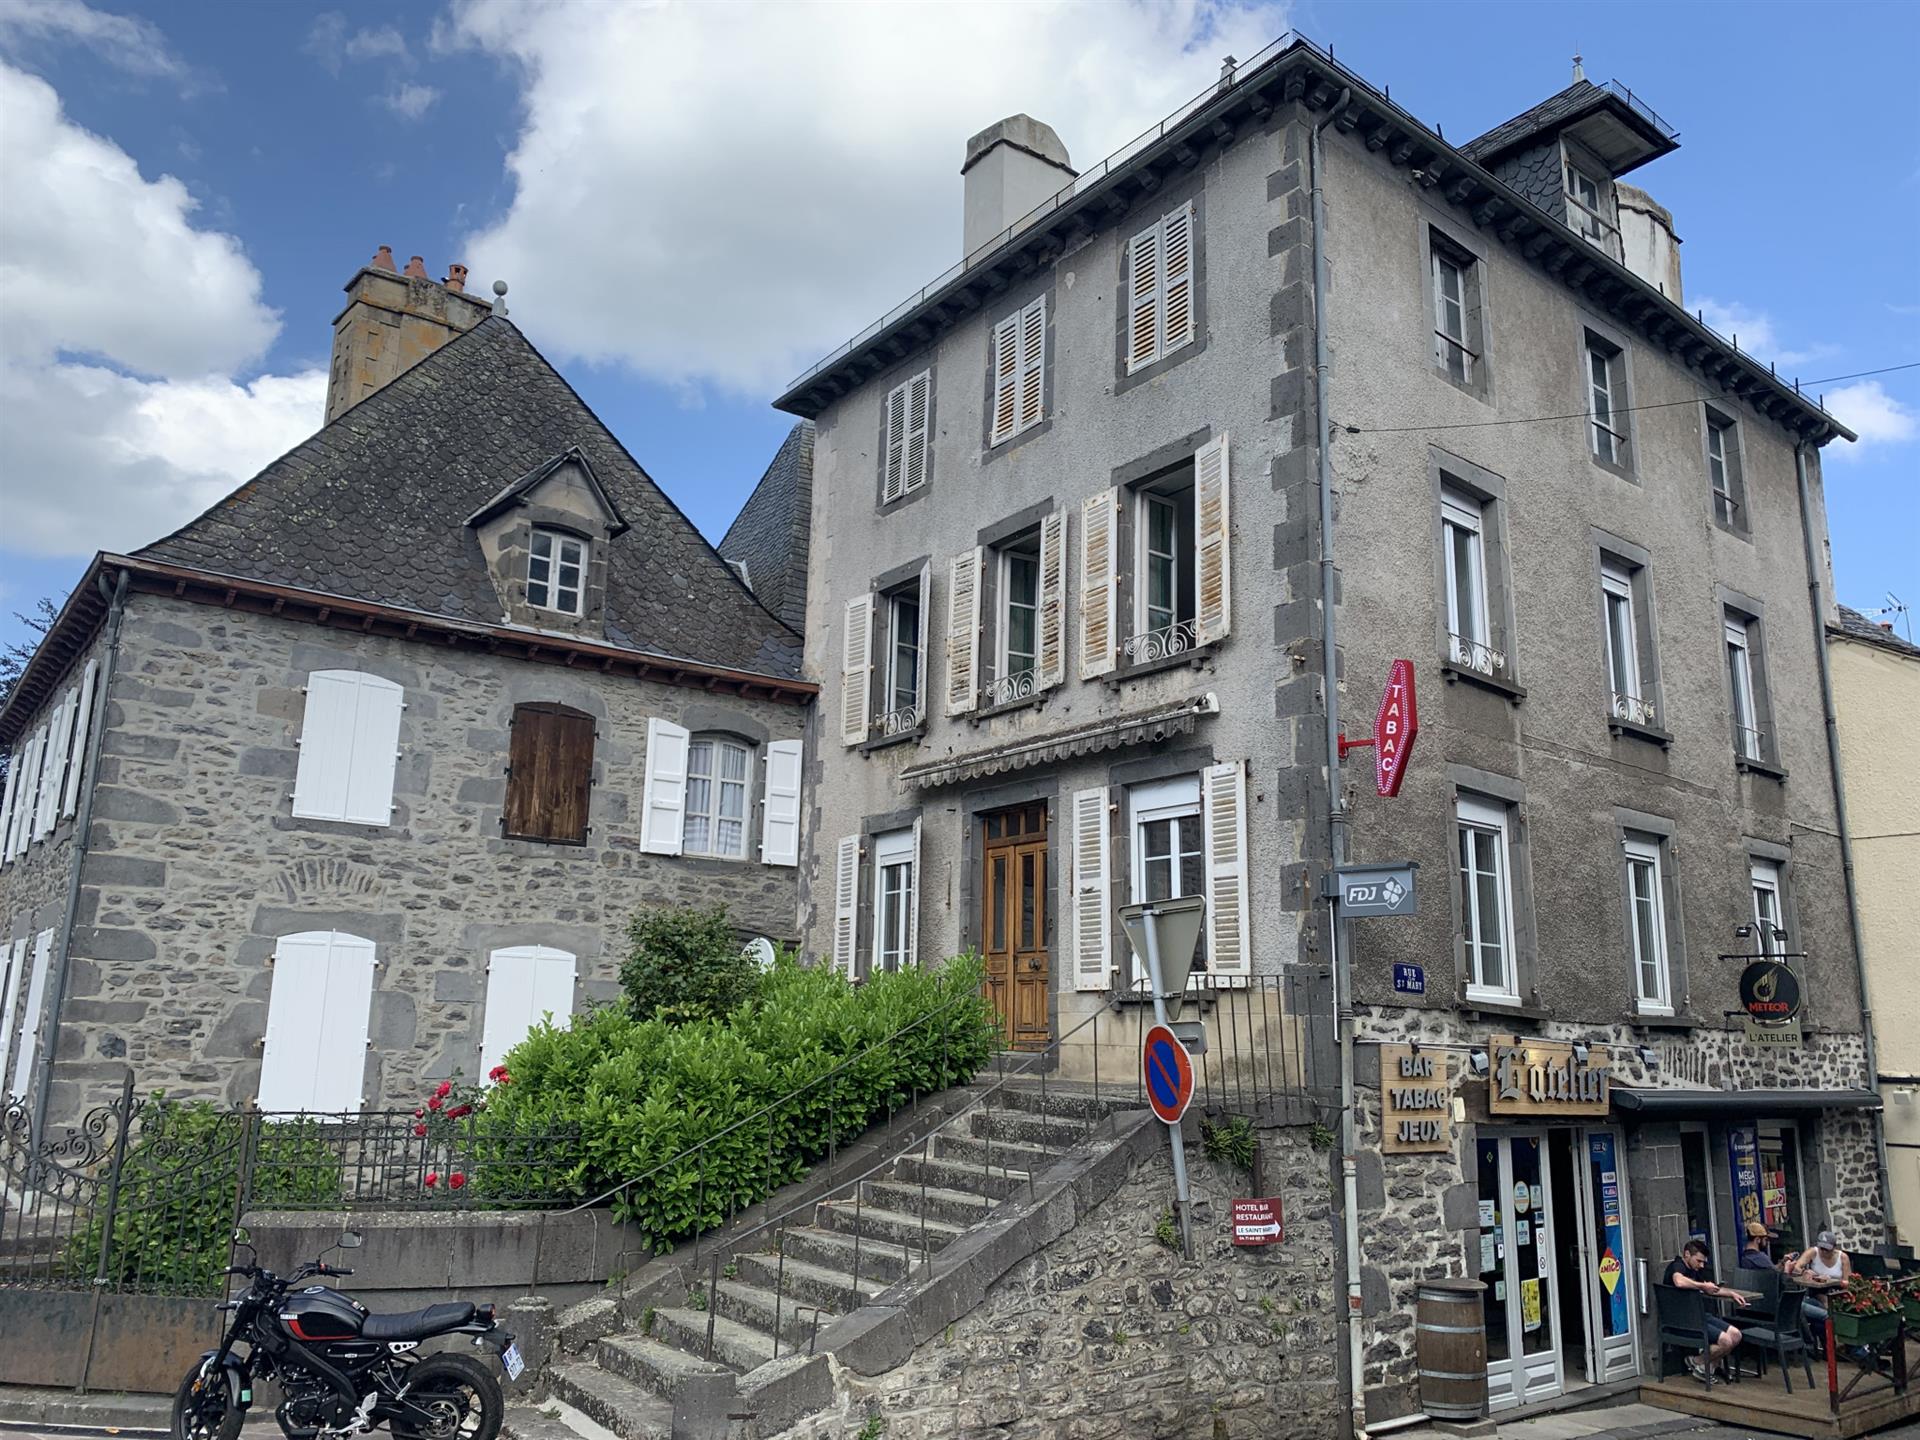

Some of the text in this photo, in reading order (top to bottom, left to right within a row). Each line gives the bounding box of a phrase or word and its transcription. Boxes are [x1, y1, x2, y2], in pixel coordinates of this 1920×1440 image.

[1382, 685, 1402, 771] TABAC
[1349, 886, 1377, 902] FDJ
[1403, 967, 1417, 977] RUE
[1749, 1002, 1789, 1012] METEOR
[1749, 1033, 1798, 1042] L'ATELIER
[1401, 1055, 1434, 1077] BAR
[1496, 1048, 1611, 1103] L'atelier
[1391, 1086, 1448, 1110] TABAC
[1398, 1120, 1444, 1142] JEUX
[1738, 1170, 1755, 1180] MEGA
